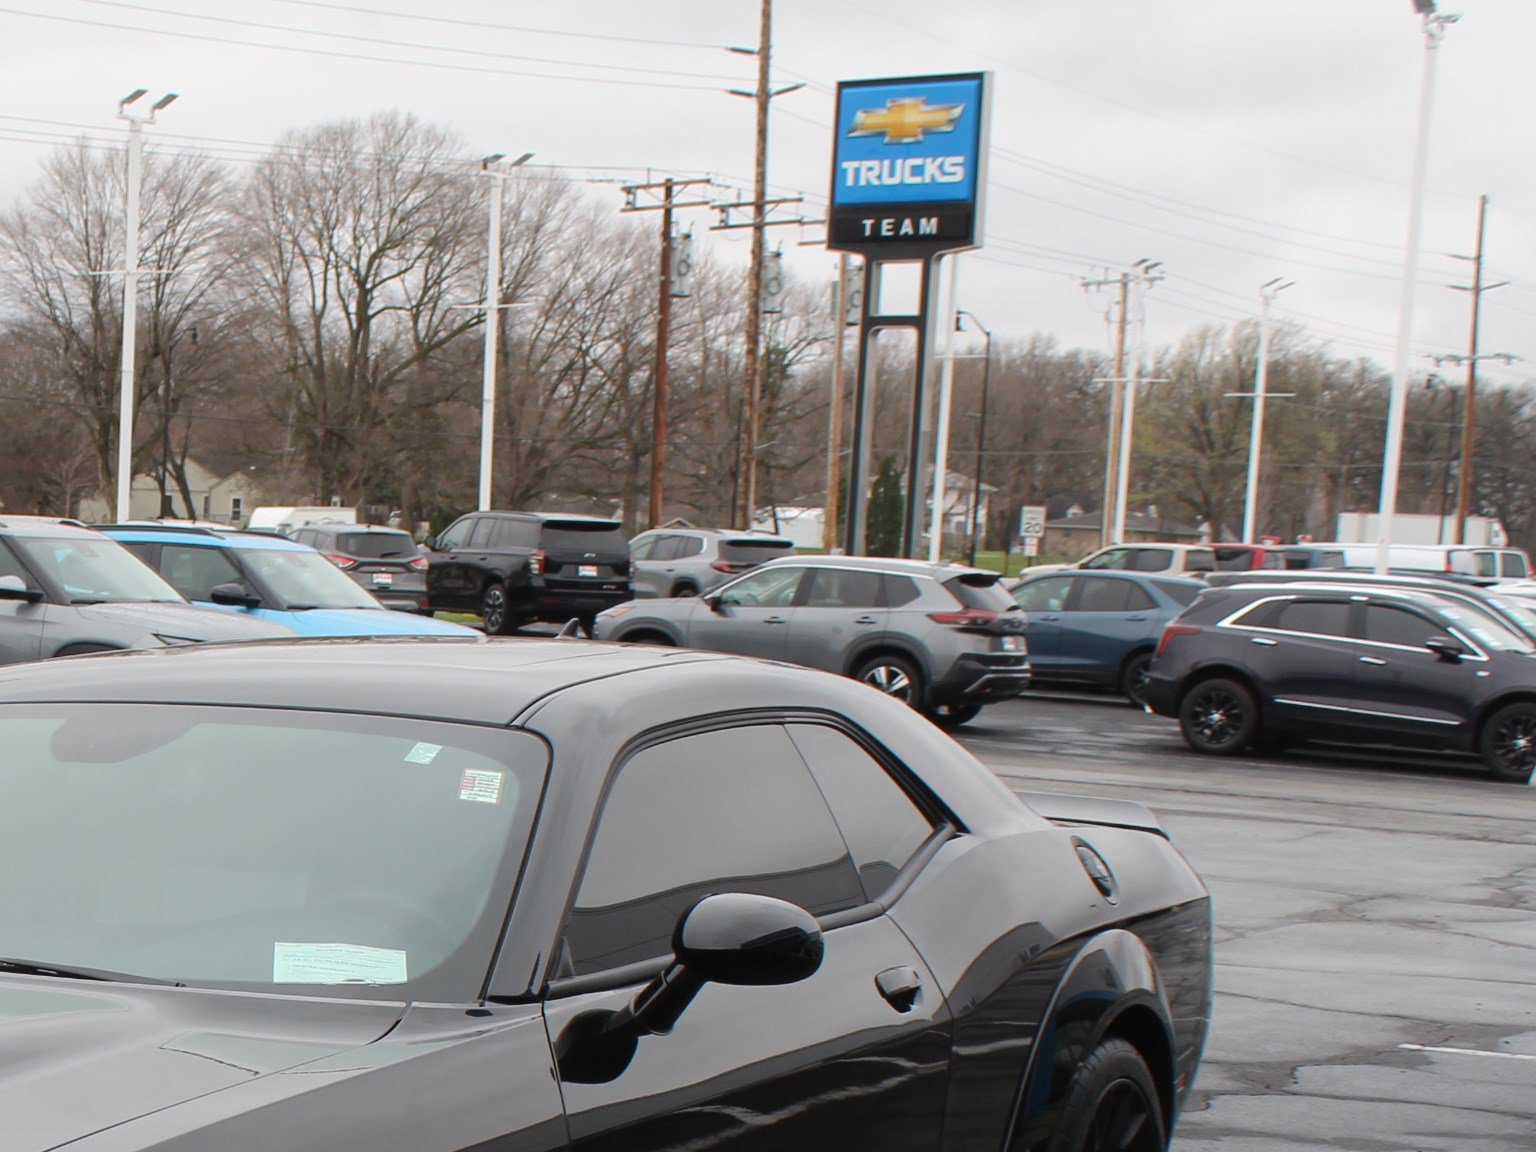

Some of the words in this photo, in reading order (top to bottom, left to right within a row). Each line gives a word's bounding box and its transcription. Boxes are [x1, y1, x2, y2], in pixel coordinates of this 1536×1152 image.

[842, 156, 965, 187] TRUCKS
[862, 217, 939, 237] TEAM
[1024, 522, 1042, 534] 20
